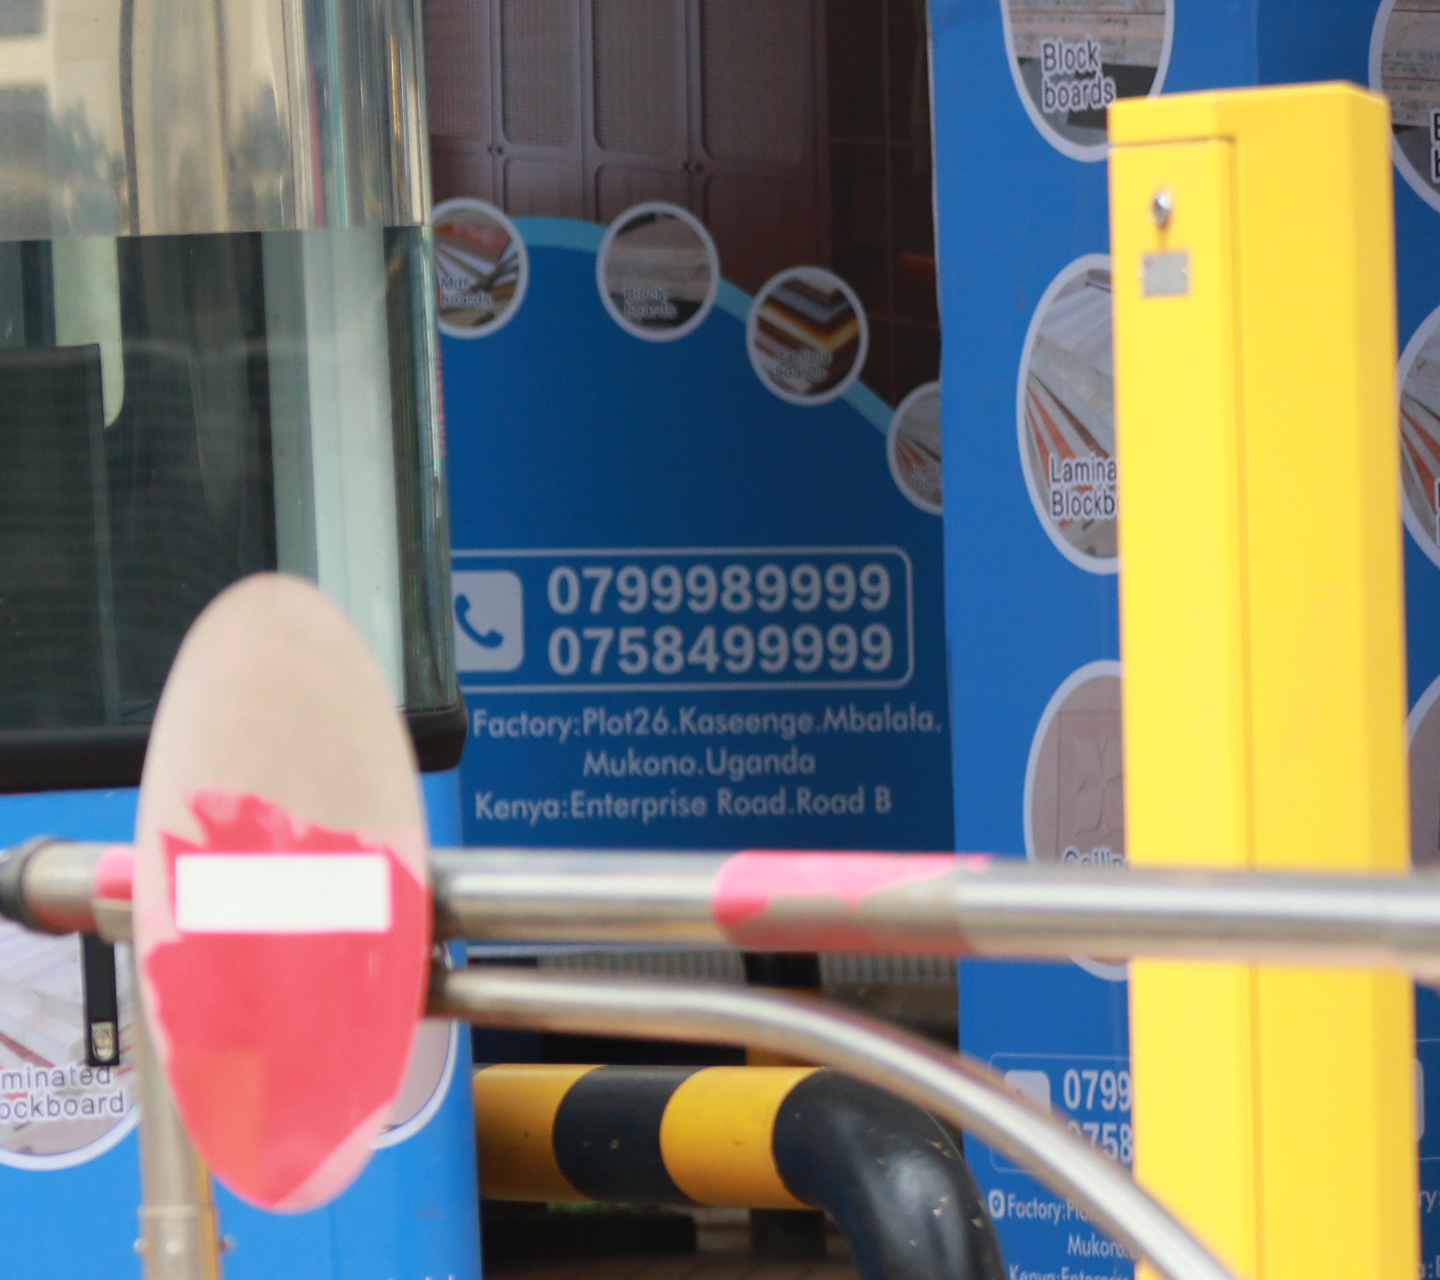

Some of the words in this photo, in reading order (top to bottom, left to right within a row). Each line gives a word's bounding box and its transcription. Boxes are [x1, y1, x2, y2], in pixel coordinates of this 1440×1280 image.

[1043, 40, 1101, 76] Block
[1043, 78, 1116, 113] boards
[547, 563, 892, 615] 0799989999
[547, 624, 895, 677] 0758499999
[582, 746, 817, 781] Mukono.Uganda
[716, 785, 865, 817] Road.Road
[875, 785, 893, 814] B
